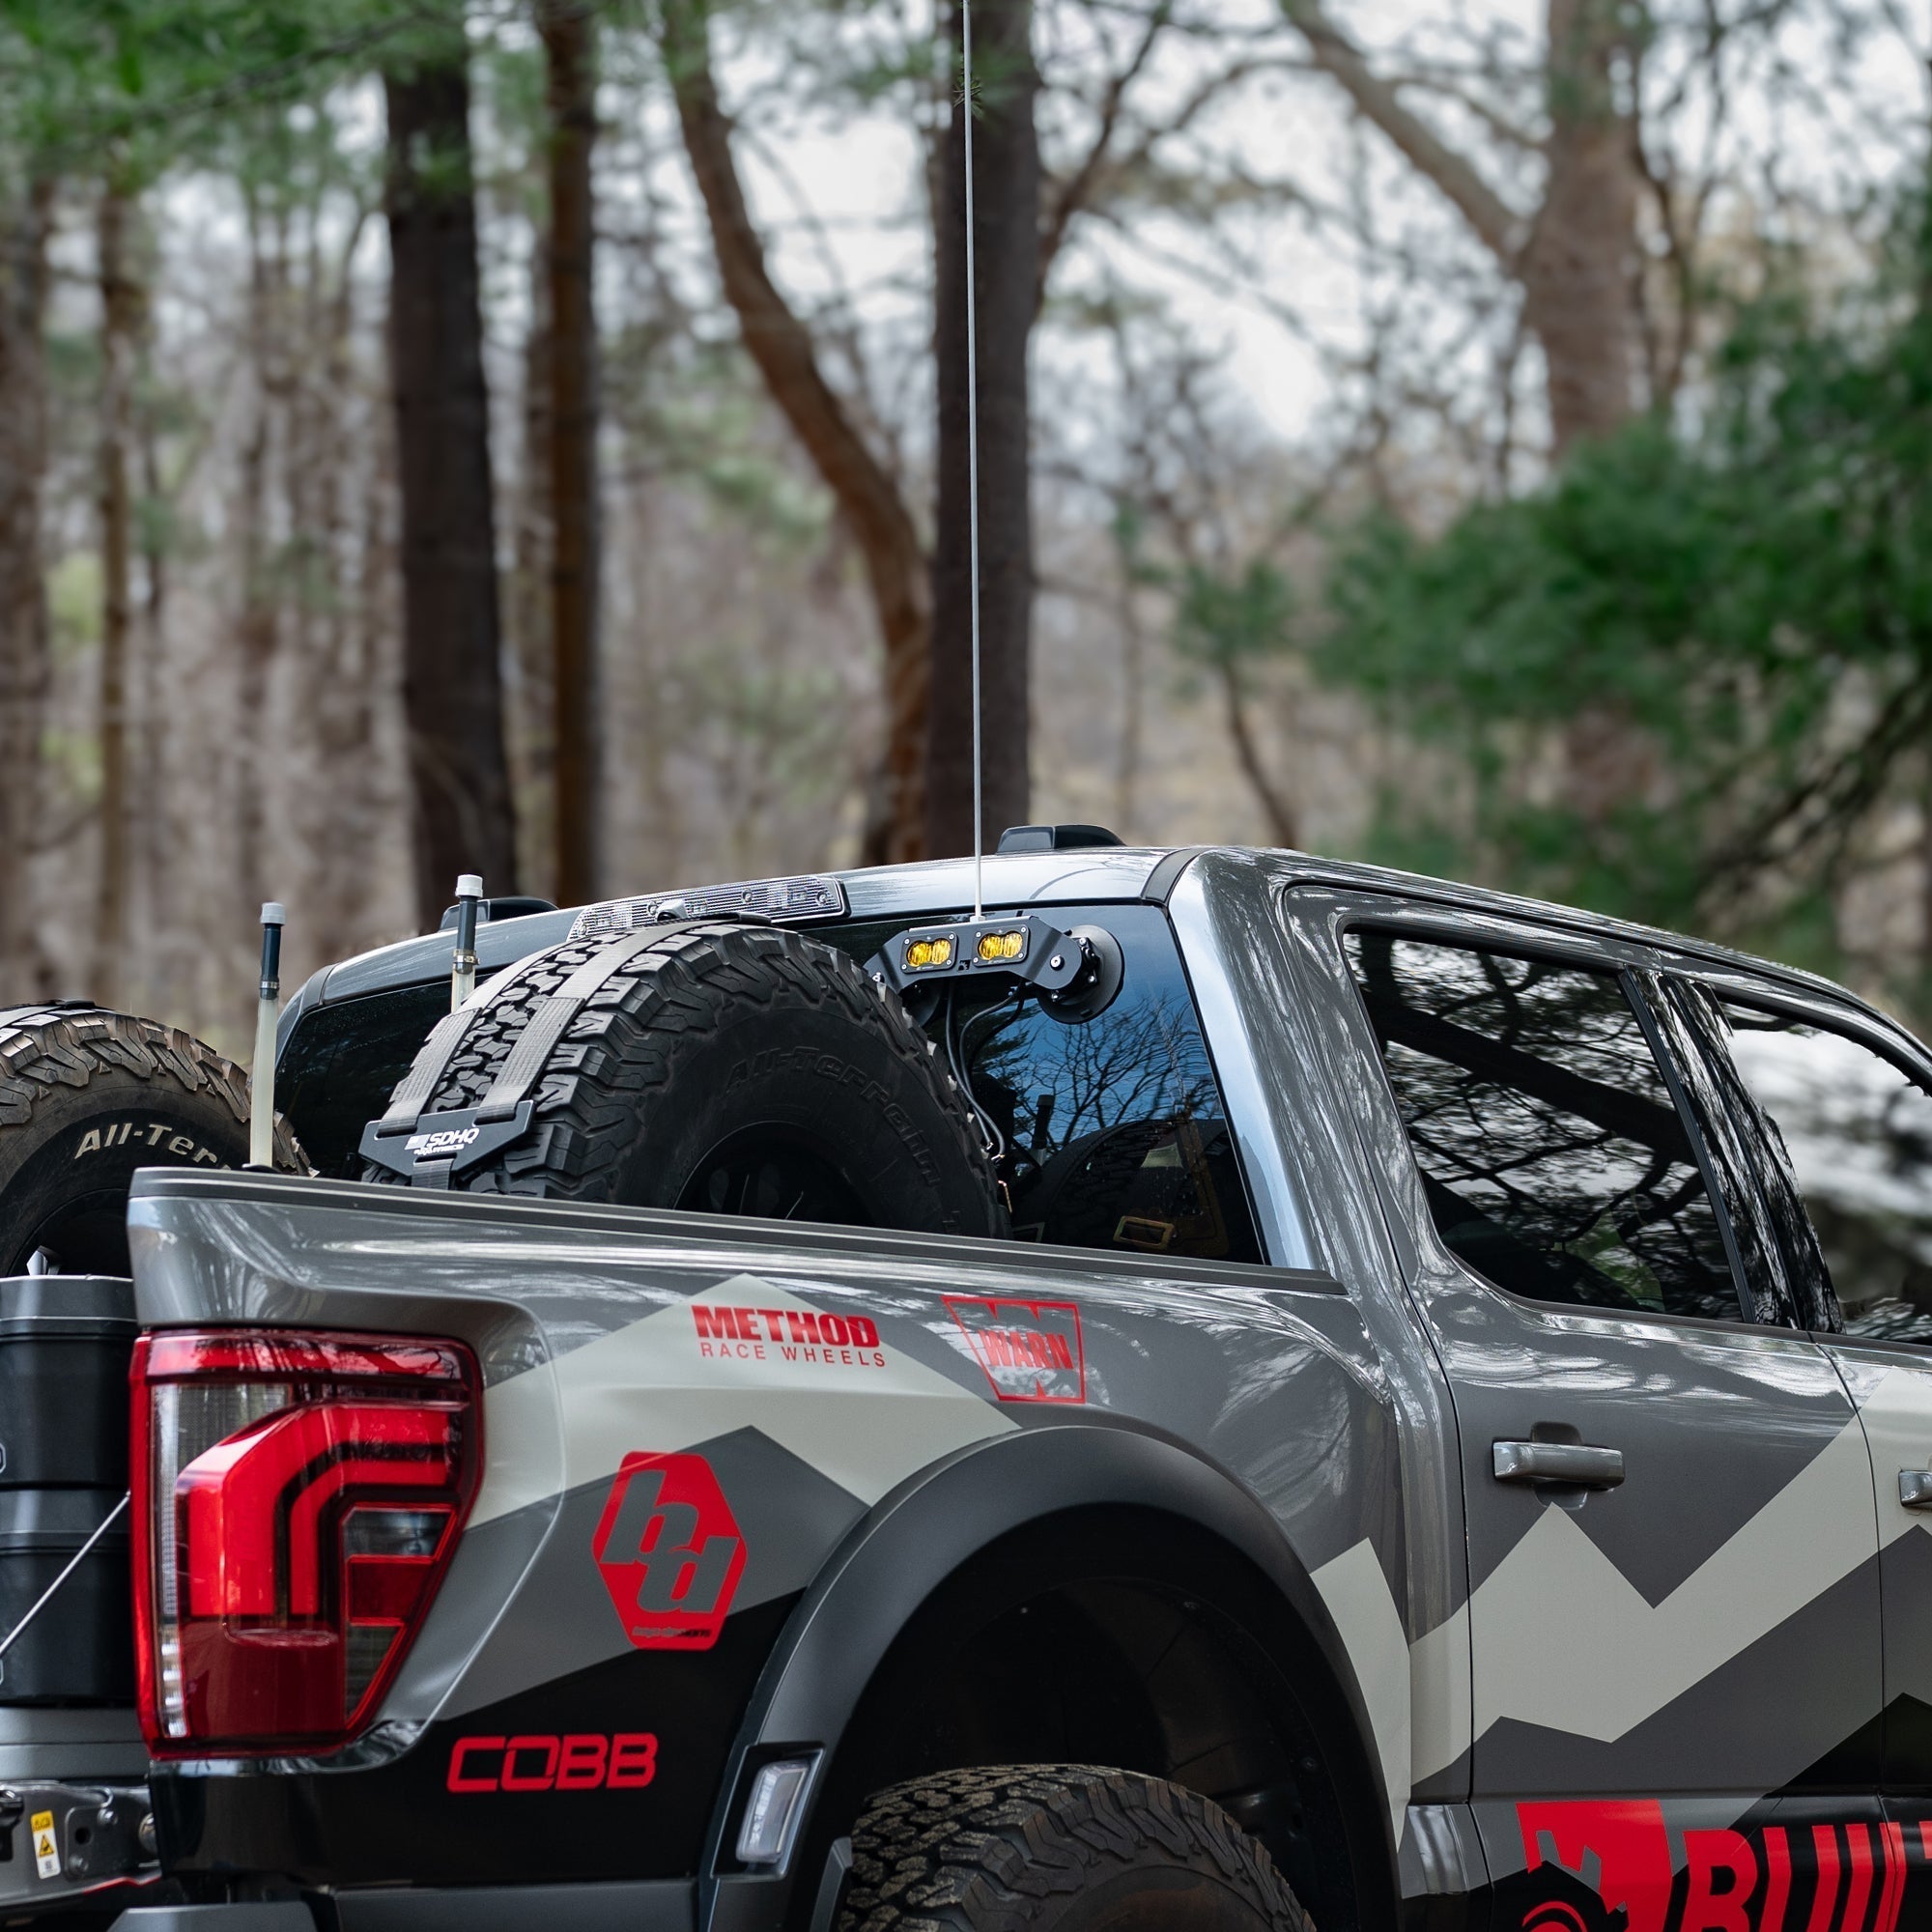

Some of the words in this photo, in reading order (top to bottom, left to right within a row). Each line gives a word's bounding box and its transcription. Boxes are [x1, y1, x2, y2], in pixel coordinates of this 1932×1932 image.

[74, 1122, 231, 1171] All-Ter
[426, 1127, 480, 1147] SDHQ
[692, 1305, 880, 1349] METHOD
[700, 1342, 766, 1360] RACE
[781, 1346, 886, 1368] WHEELS
[978, 1329, 1075, 1370] WARN
[446, 1732, 659, 1793] COBB
